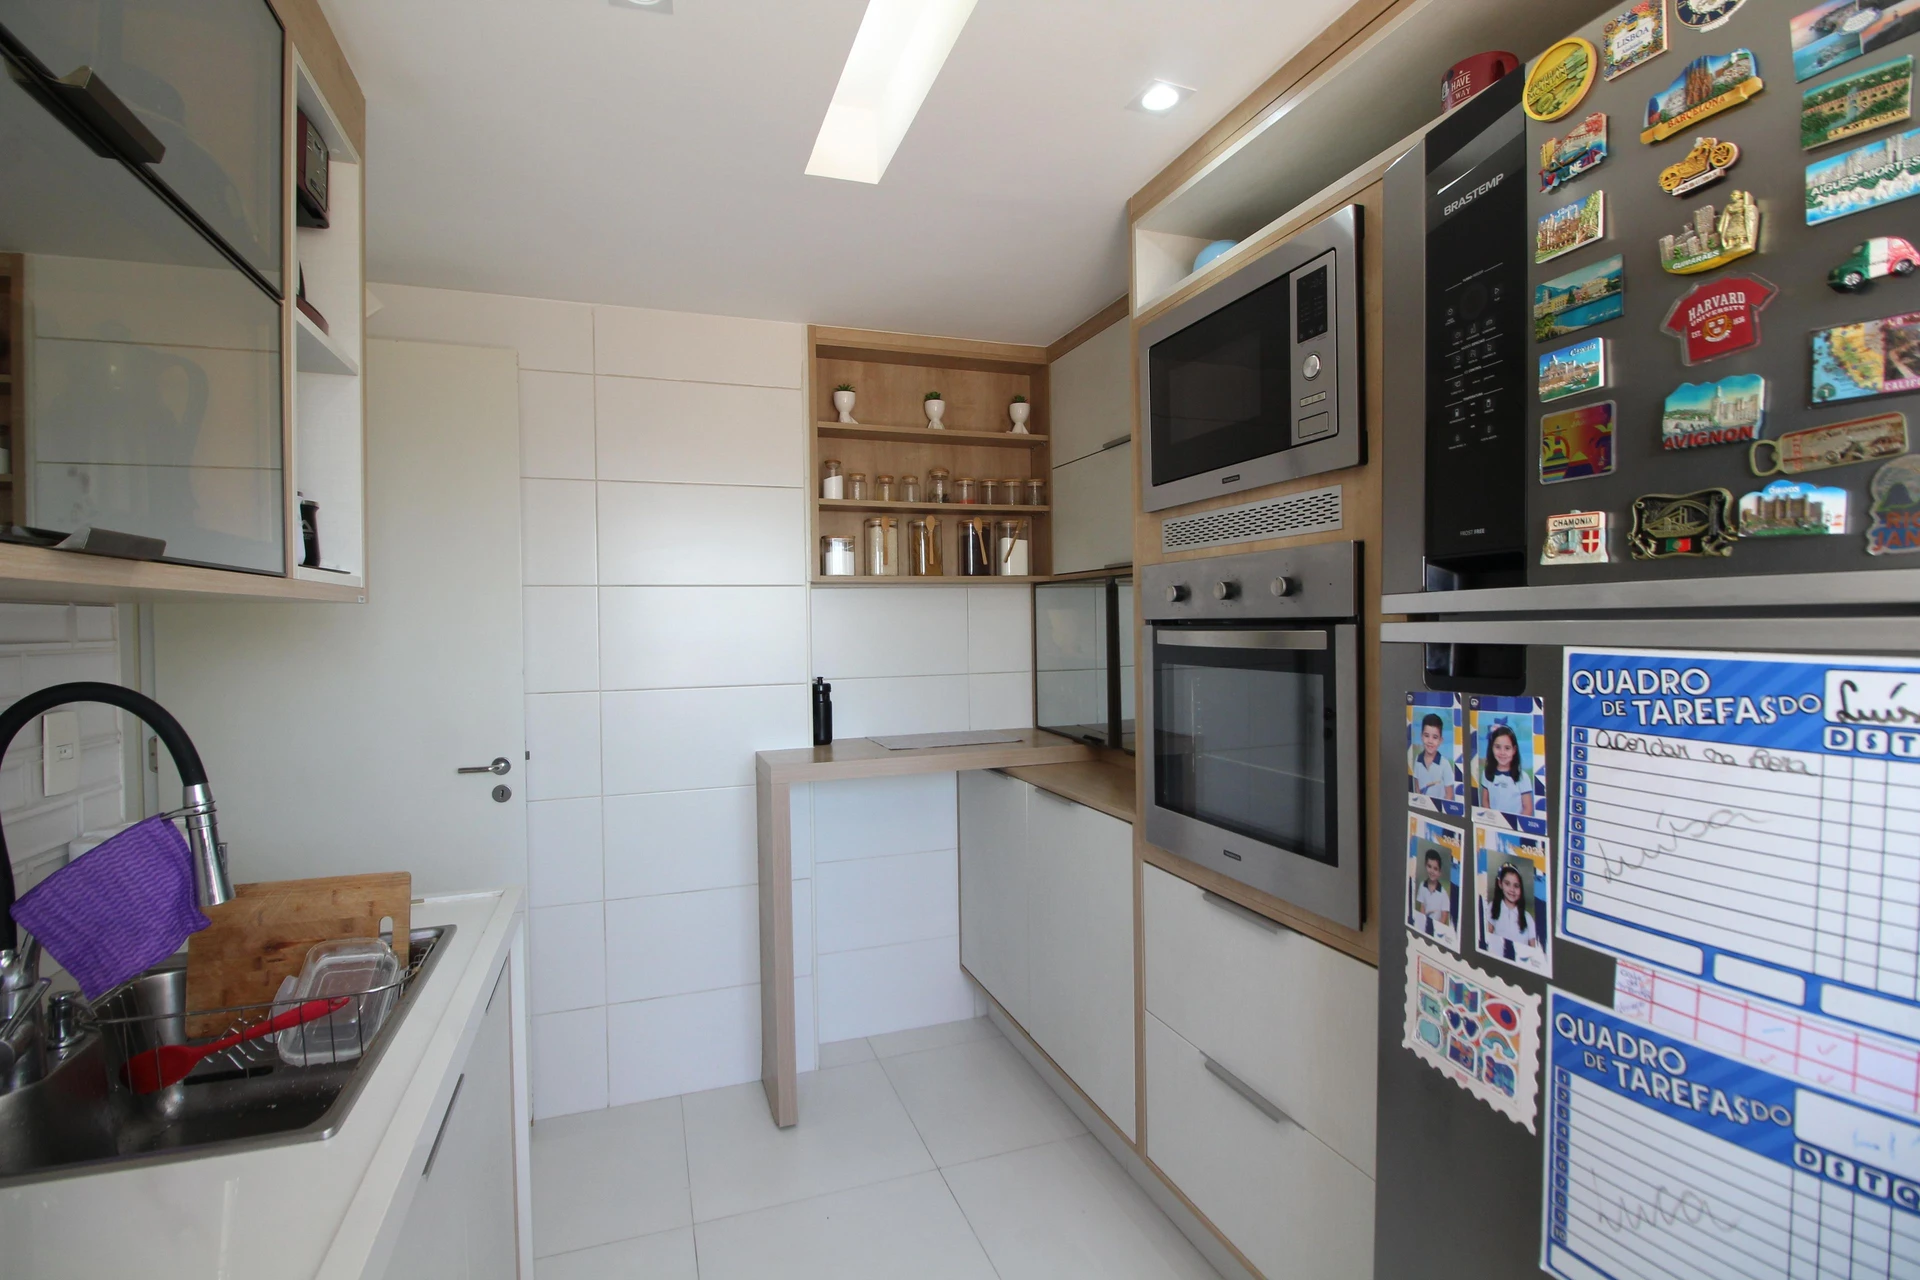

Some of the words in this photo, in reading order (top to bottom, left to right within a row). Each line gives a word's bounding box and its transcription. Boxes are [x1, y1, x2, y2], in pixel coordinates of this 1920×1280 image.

[1616, 27, 1650, 49] LISBOA
[1451, 73, 1471, 92] HAVE
[1455, 86, 1471, 99] WAY
[1667, 95, 1726, 129] BARCELONA
[1444, 173, 1505, 216] BRASTEMP
[1688, 291, 1747, 322] HARVARD
[1690, 305, 1746, 327] UNIVERSITY
[1885, 377, 1920, 392] CALIF
[1663, 425, 1755, 450] AVIGNON
[1552, 516, 1594, 528] CHAMONIX
[1572, 668, 1711, 699] QUADRO
[1602, 701, 1627, 717] DE
[1631, 695, 1778, 726] TAREFAS
[1778, 693, 1823, 715] DO
[1830, 729, 1848, 746] D
[1866, 733, 1877, 750] S
[1898, 735, 1916, 753] T
[1577, 750, 1584, 759] 2
[1577, 767, 1584, 777] 3
[1576, 785, 1583, 794] 4
[1575, 803, 1583, 812] 5
[1575, 821, 1582, 830] 6
[1575, 839, 1582, 848] 7
[1573, 856, 1581, 866] 8
[1573, 874, 1580, 883] 9
[1569, 890, 1583, 902] 10
[1555, 1012, 1687, 1077] QUADRO
[1583, 1051, 1608, 1073] DE
[1611, 1059, 1750, 1126] TAREFAS
[1750, 1100, 1793, 1128] DO
[1800, 1148, 1816, 1165] D
[1834, 1161, 1844, 1178] S
[1864, 1171, 1882, 1190] T
